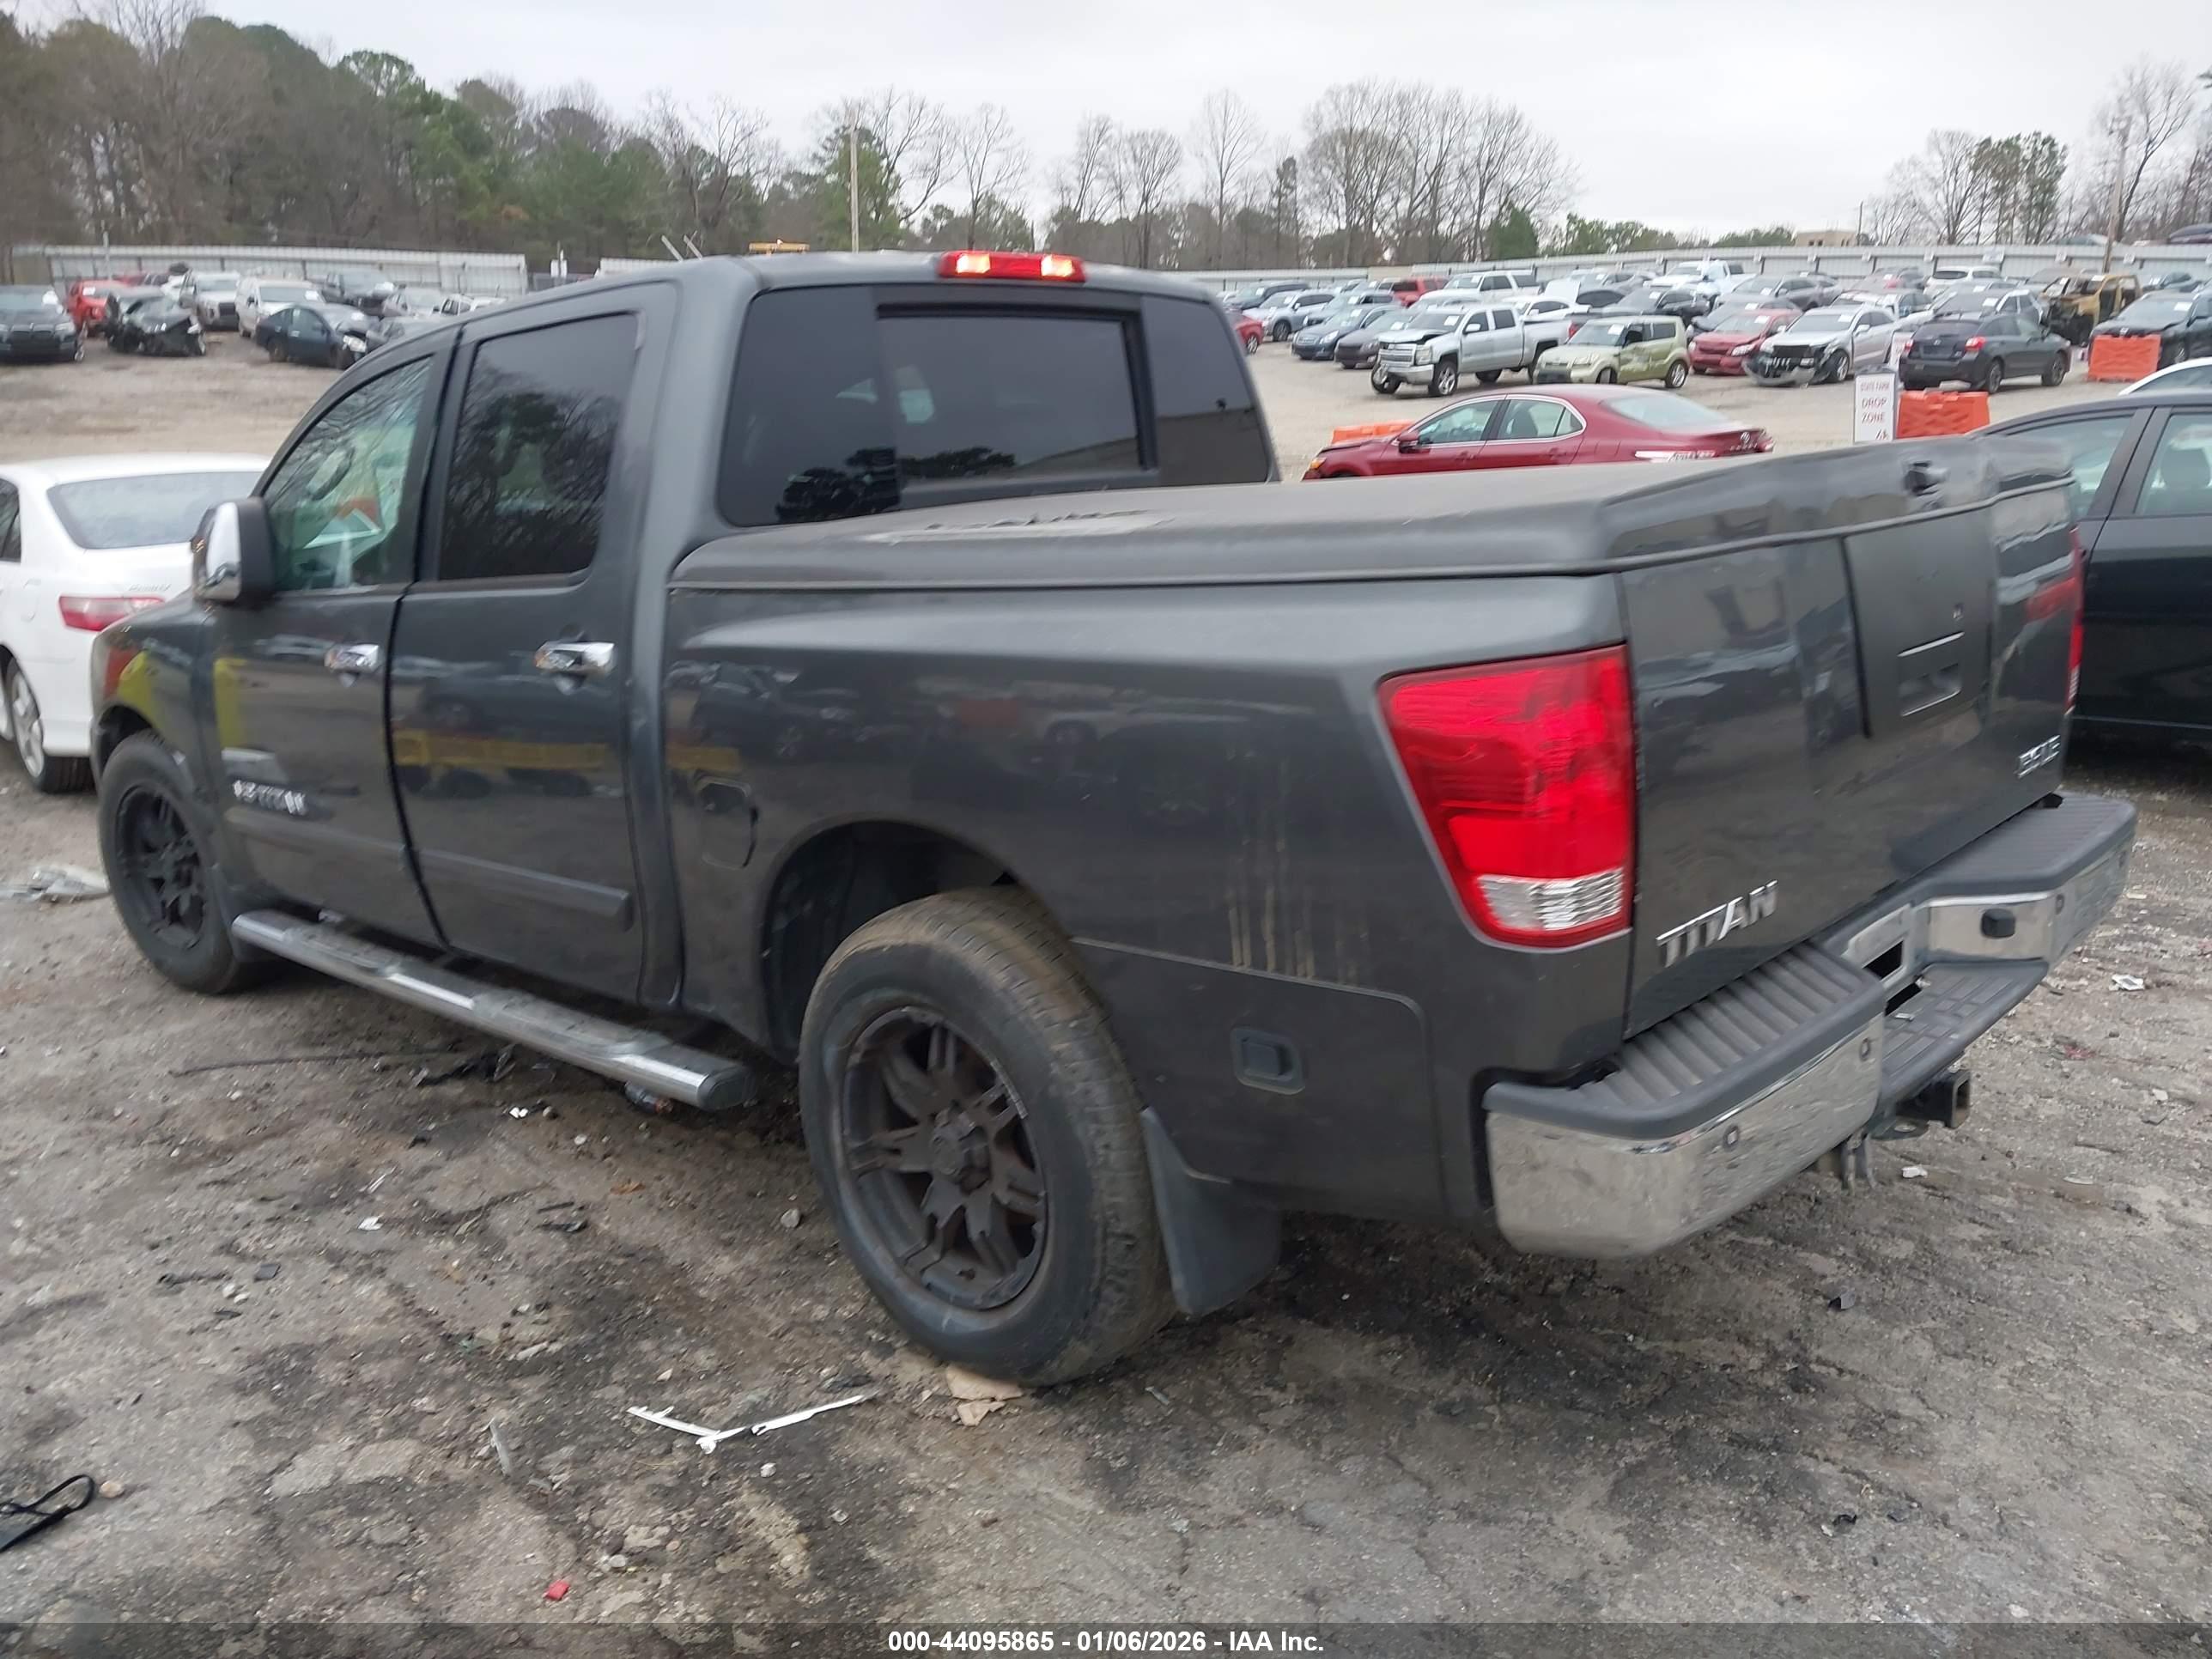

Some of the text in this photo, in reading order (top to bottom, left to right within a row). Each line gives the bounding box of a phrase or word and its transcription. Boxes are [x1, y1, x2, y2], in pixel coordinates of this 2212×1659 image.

[1862, 398, 1887, 409] DROP
[1862, 412, 1884, 424] ZONE
[1655, 878, 1778, 968] TITAN
